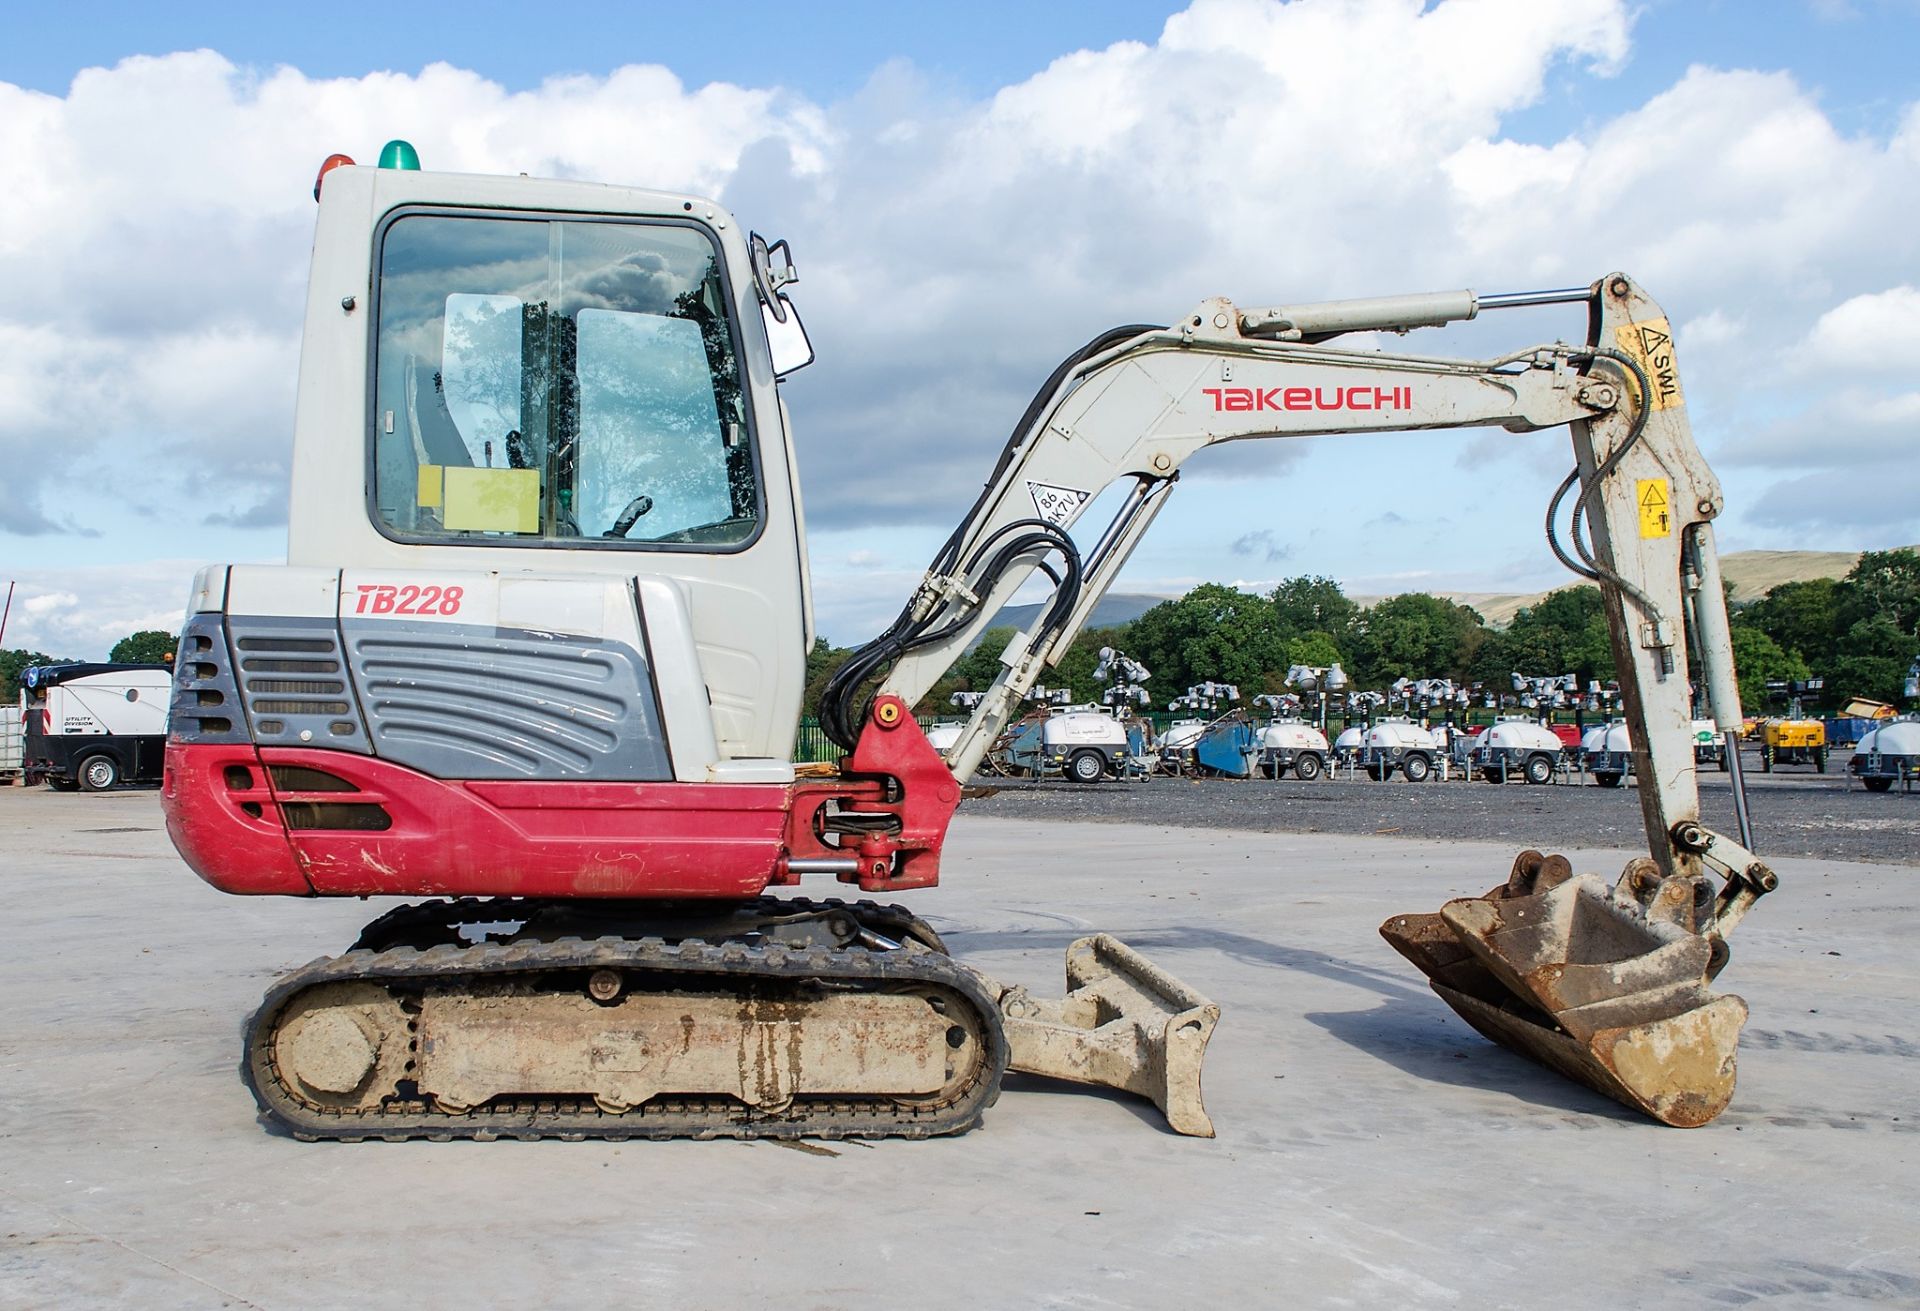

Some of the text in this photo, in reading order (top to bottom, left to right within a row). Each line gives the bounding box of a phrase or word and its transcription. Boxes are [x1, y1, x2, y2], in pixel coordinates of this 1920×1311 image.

[1654, 355, 1676, 405] SWL
[1202, 387, 1411, 411] TAKEUCHI
[1040, 492, 1057, 509] 86
[356, 585, 464, 615] TB228
